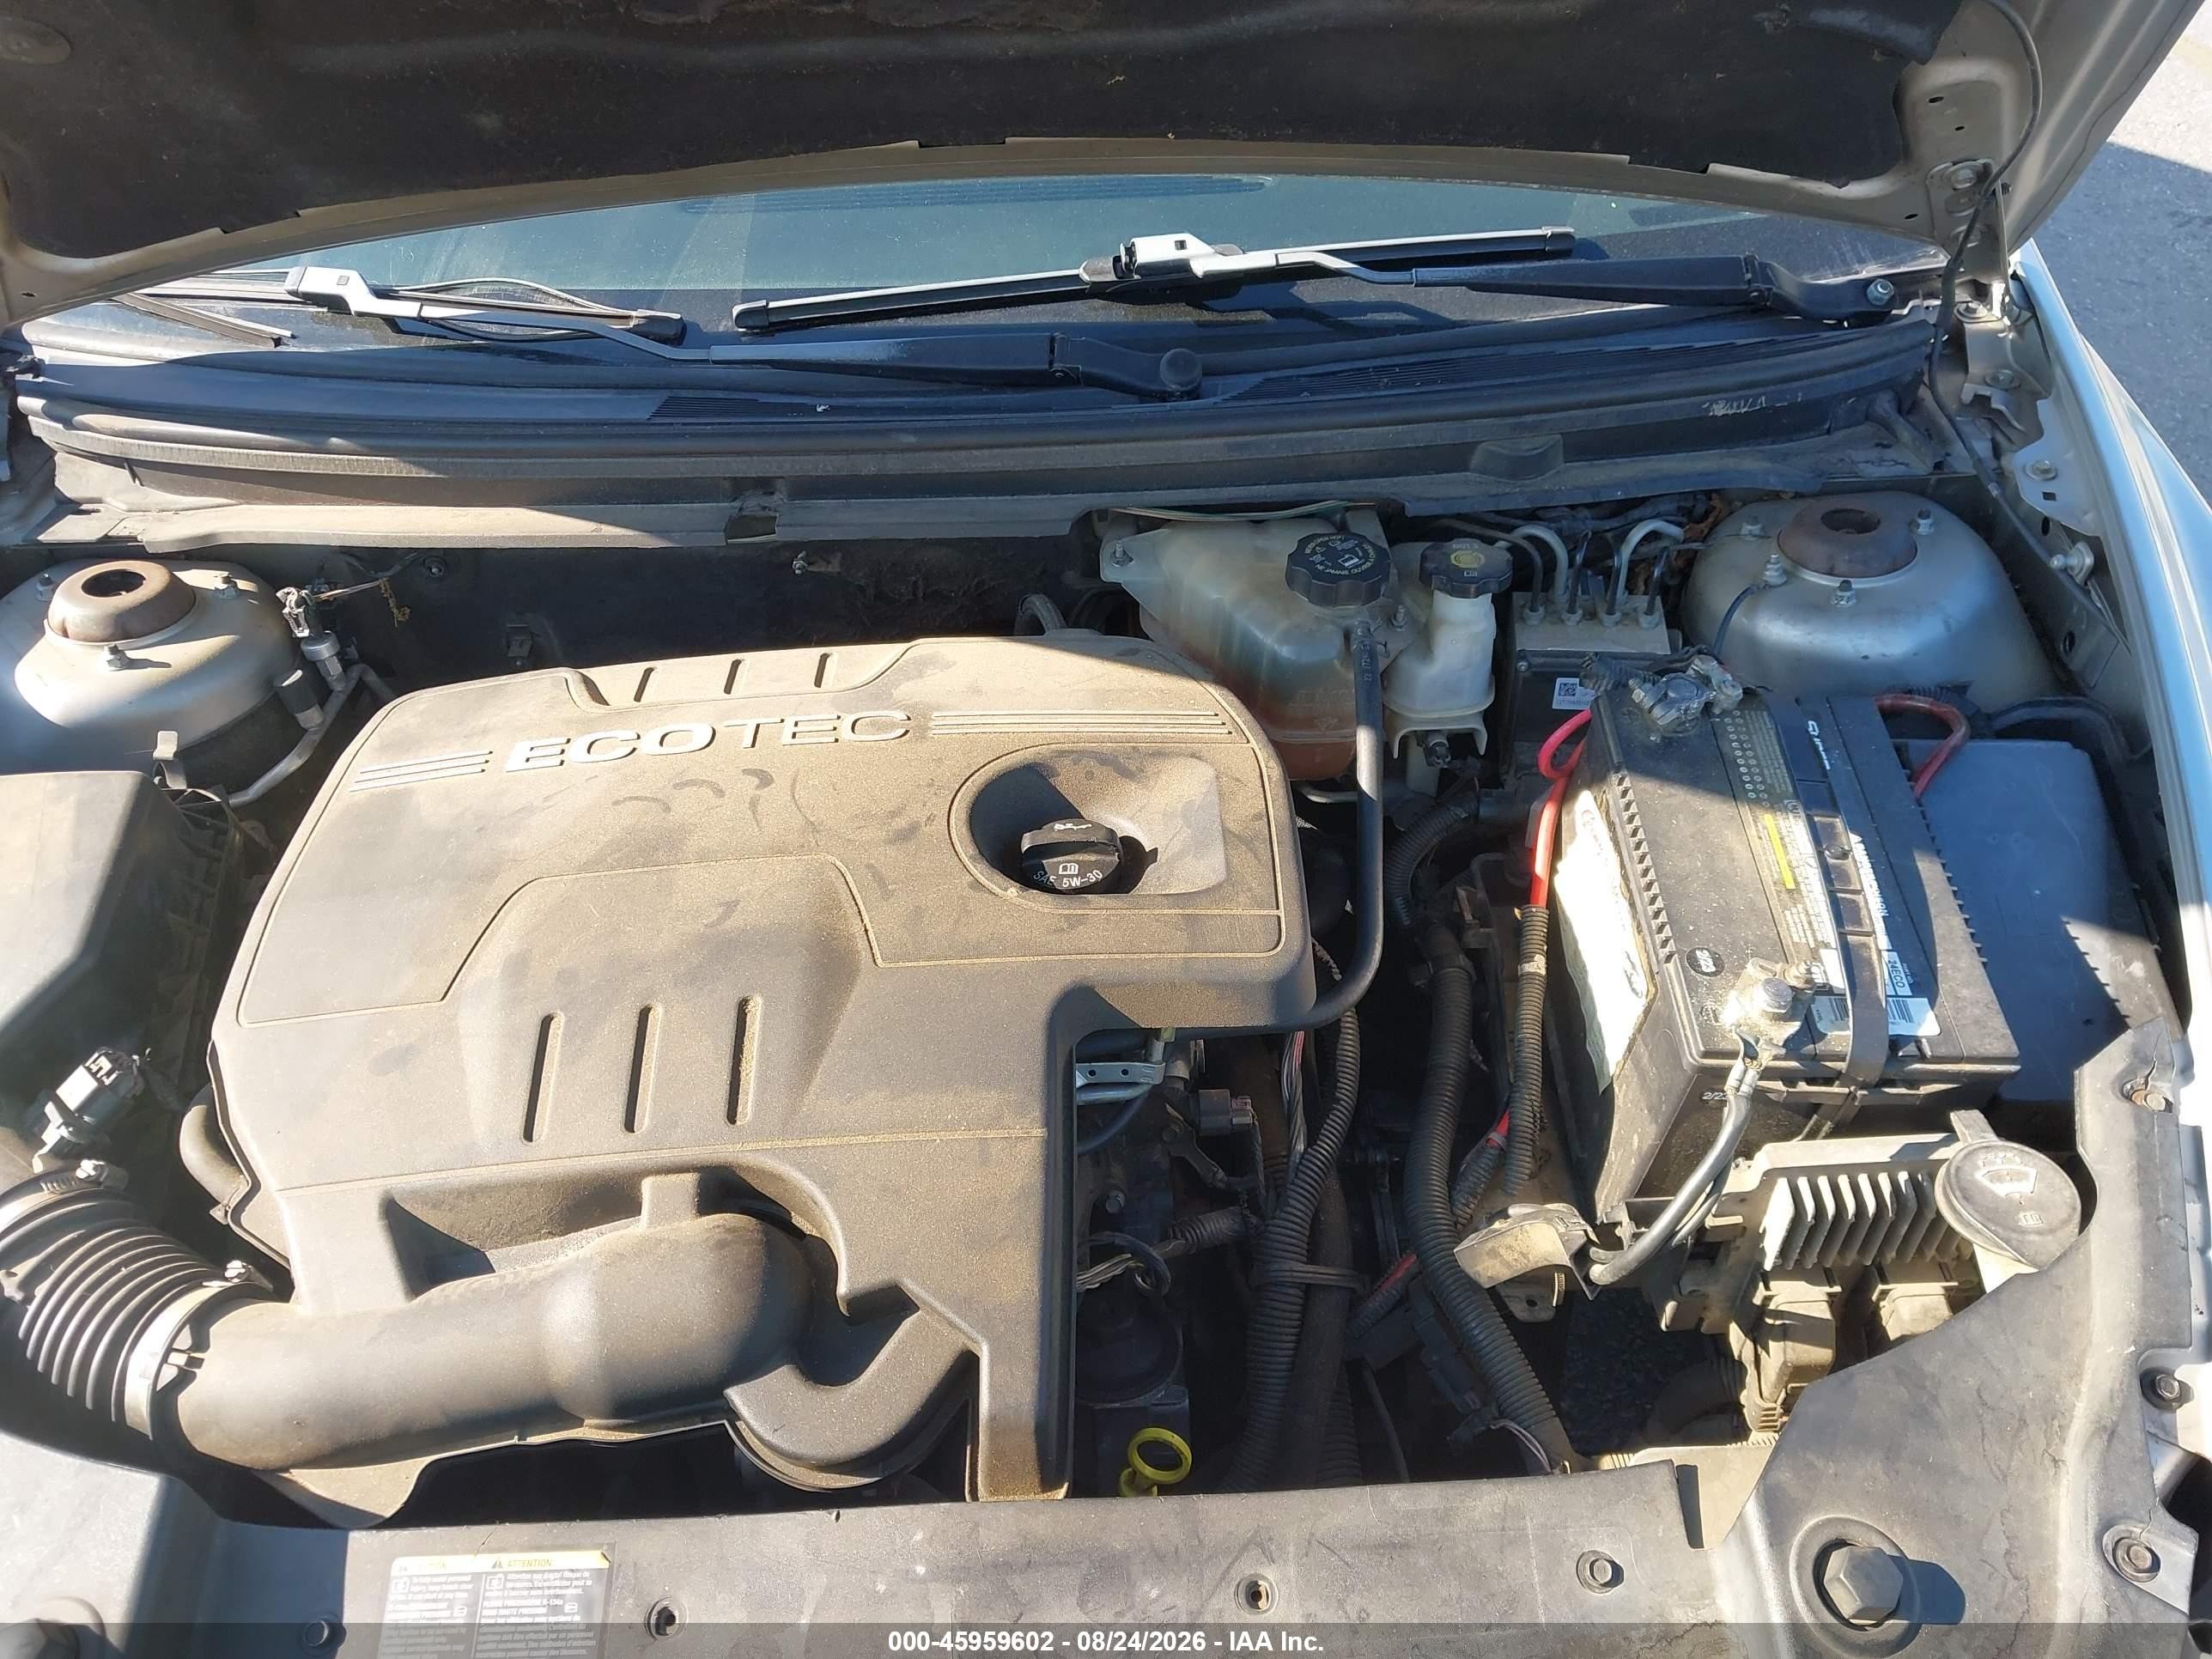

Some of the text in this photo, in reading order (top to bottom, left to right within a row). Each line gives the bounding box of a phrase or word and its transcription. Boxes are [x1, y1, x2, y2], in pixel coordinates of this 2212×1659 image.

[505, 709, 912, 773] ECOTEC
[1033, 869, 1103, 888] SAE 5W-30
[1887, 959, 1905, 988] 24ECO
[507, 1559, 552, 1568] ATTENTION
